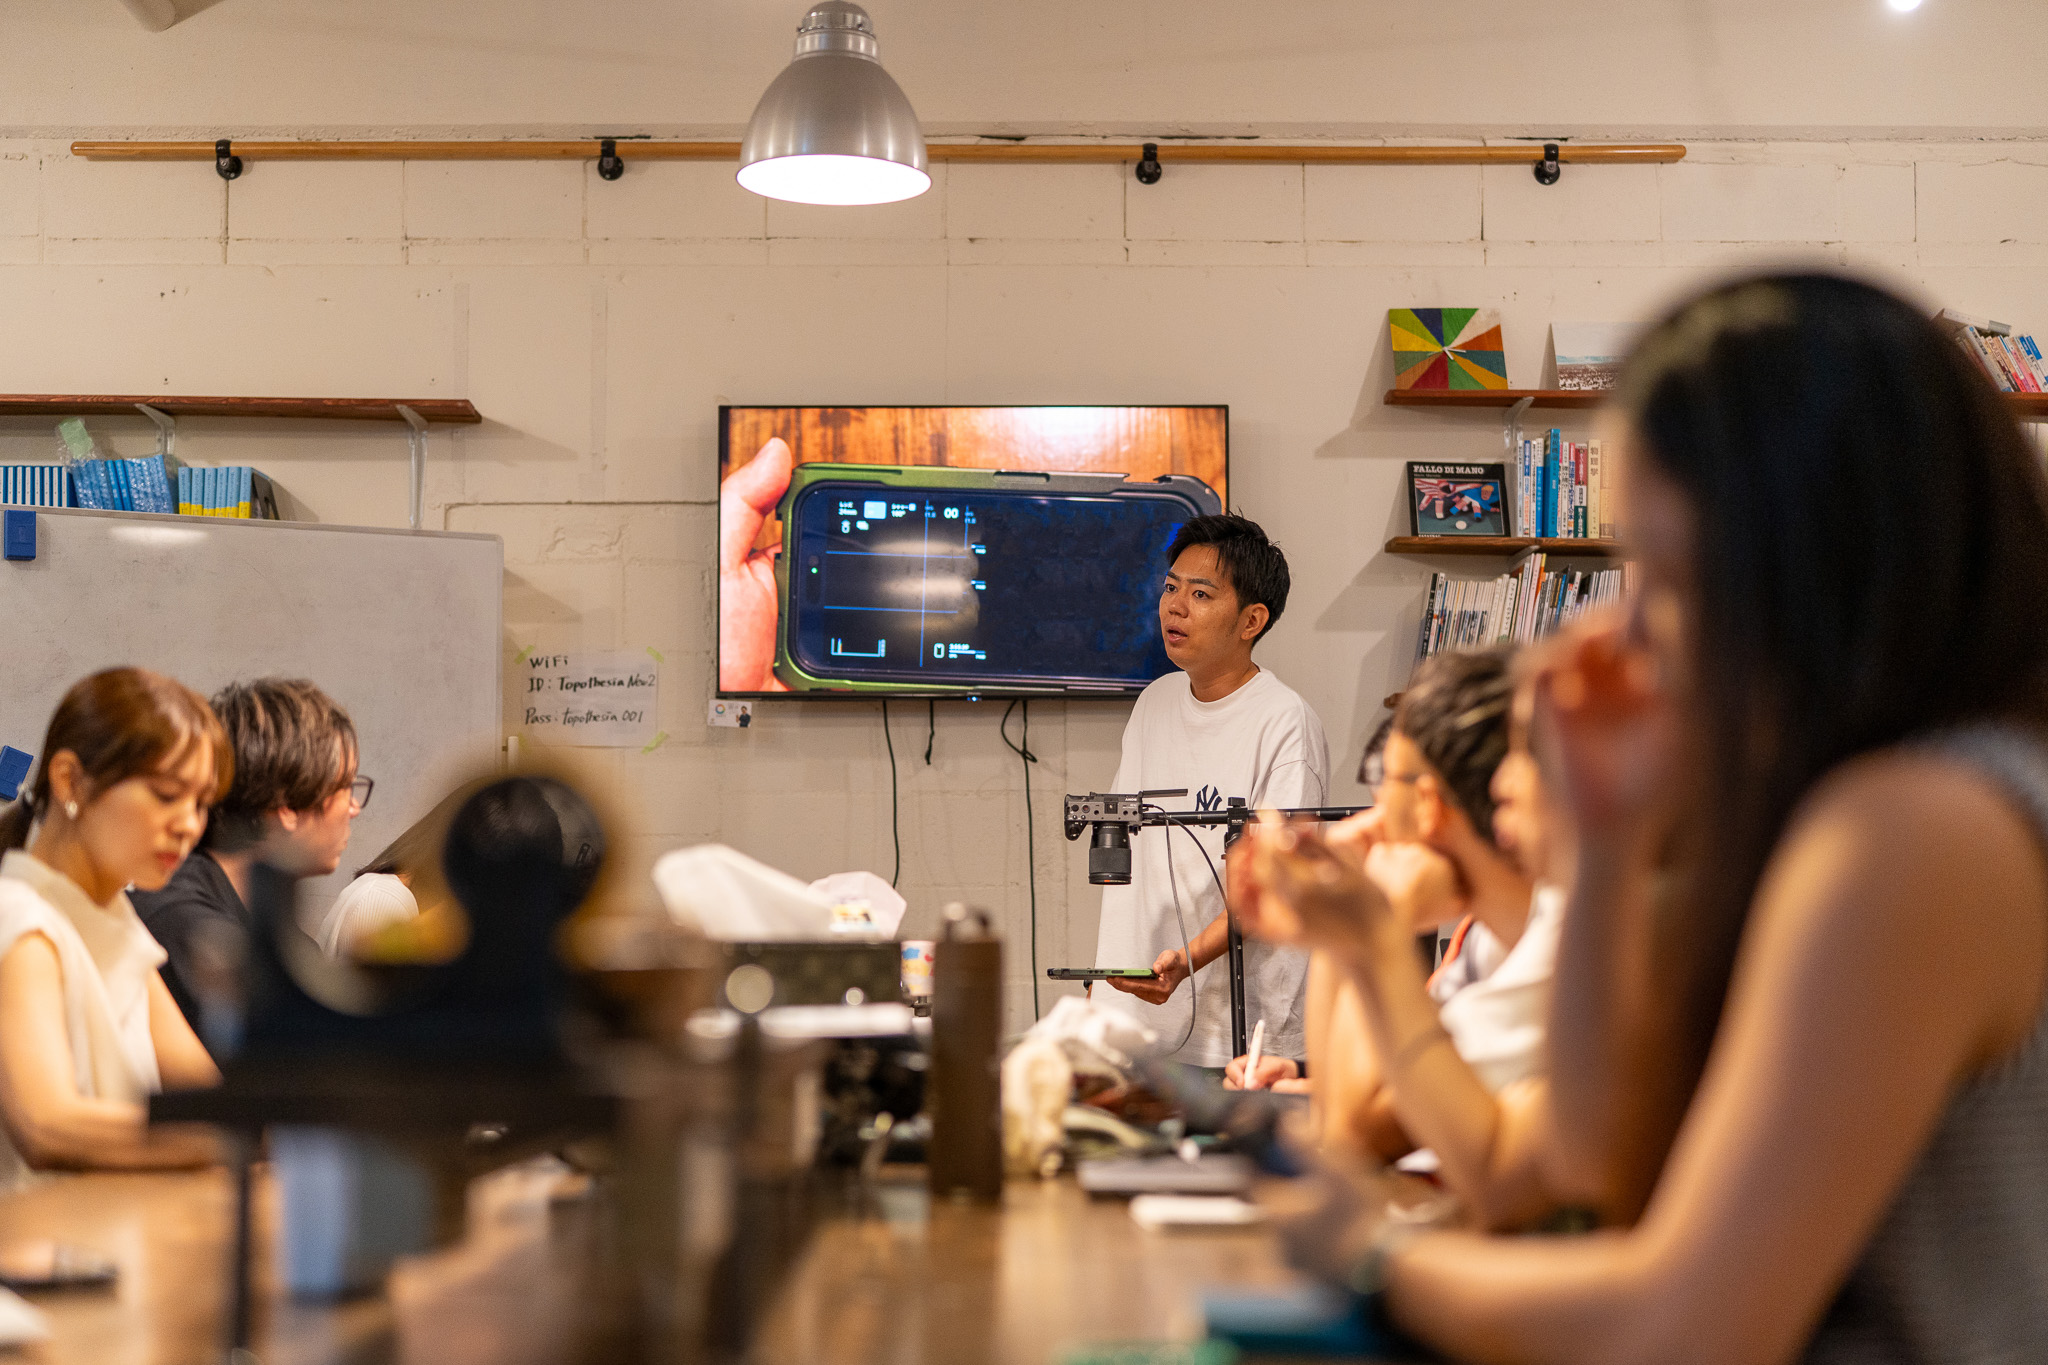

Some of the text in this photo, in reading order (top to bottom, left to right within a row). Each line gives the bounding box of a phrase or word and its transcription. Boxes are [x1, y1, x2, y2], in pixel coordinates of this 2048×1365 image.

[1413, 465, 1484, 475] FALLO DI MANO
[1590, 446, 1599, 476] 物理学
